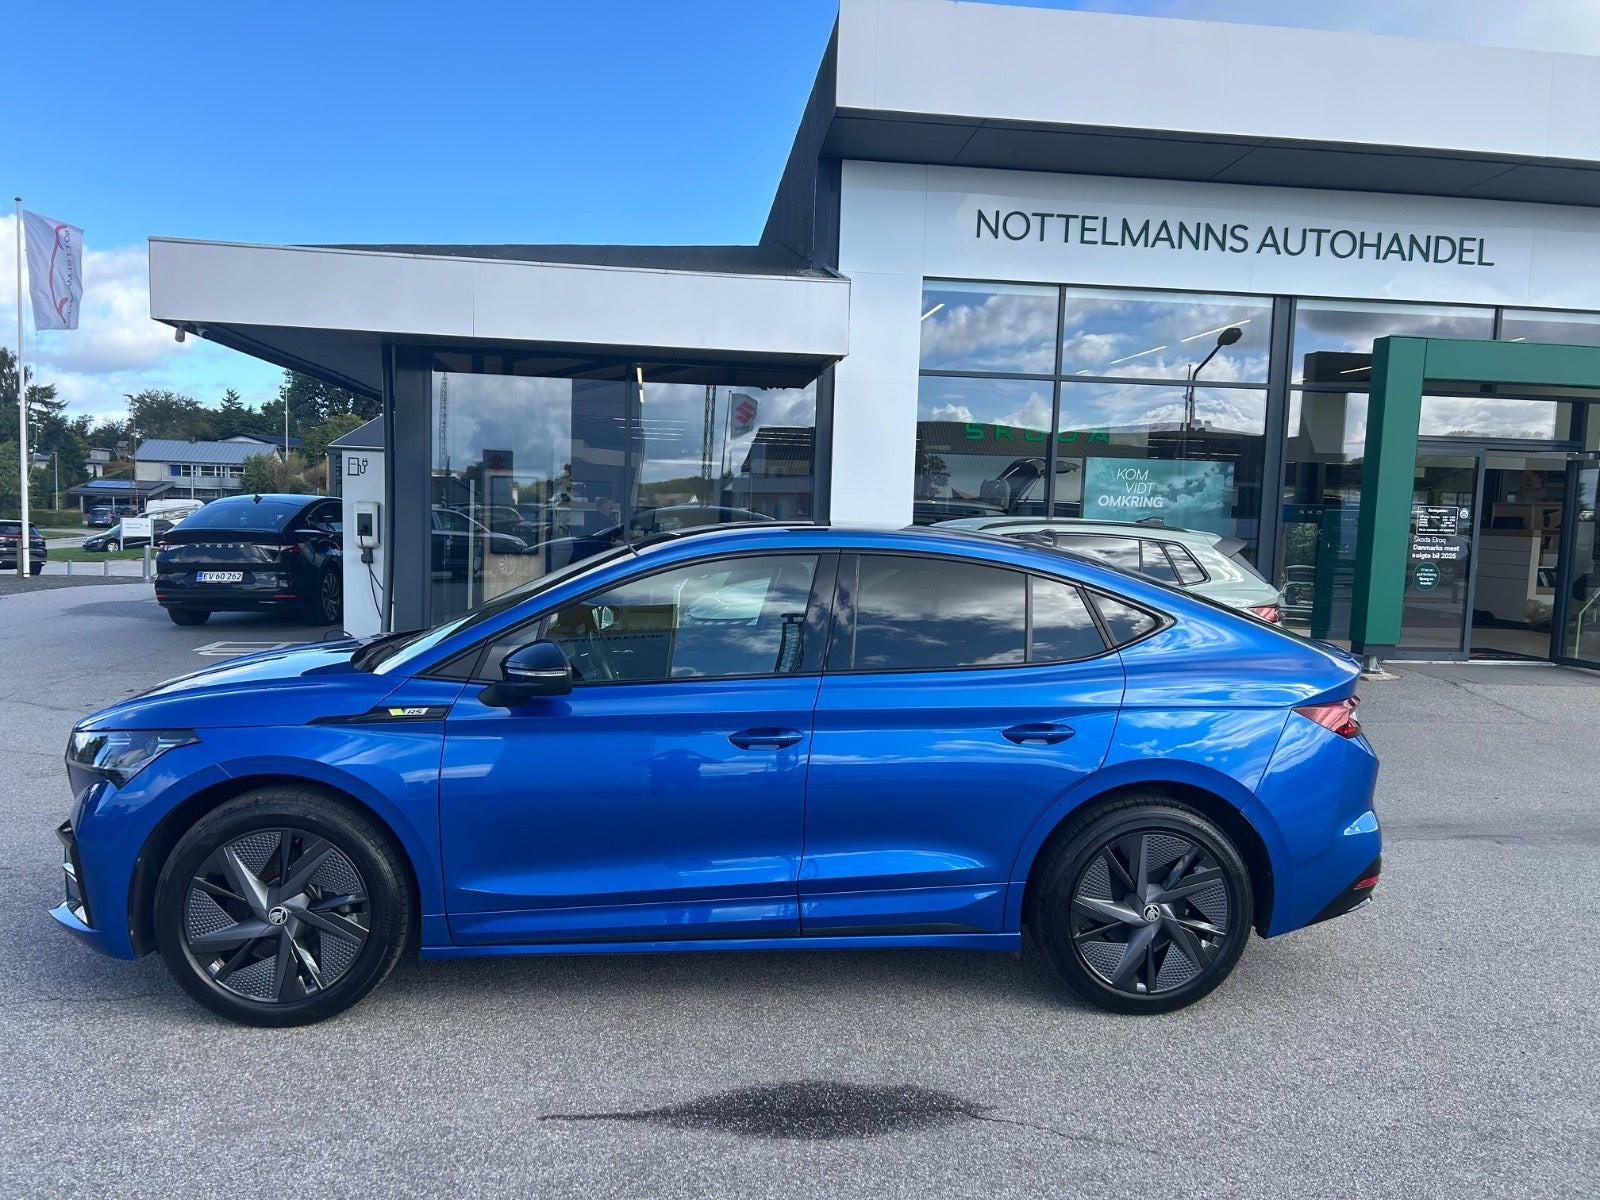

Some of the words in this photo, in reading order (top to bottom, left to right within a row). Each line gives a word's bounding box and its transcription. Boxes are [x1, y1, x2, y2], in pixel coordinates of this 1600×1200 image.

[976, 209, 1249, 253] NOTTELMANNS
[1256, 226, 1495, 267] AUTOHANDEL
[1117, 468, 1149, 480] KOM
[1125, 482, 1156, 494] VIDT
[1098, 495, 1164, 508] OMKRING
[1412, 552, 1431, 560] solgte
